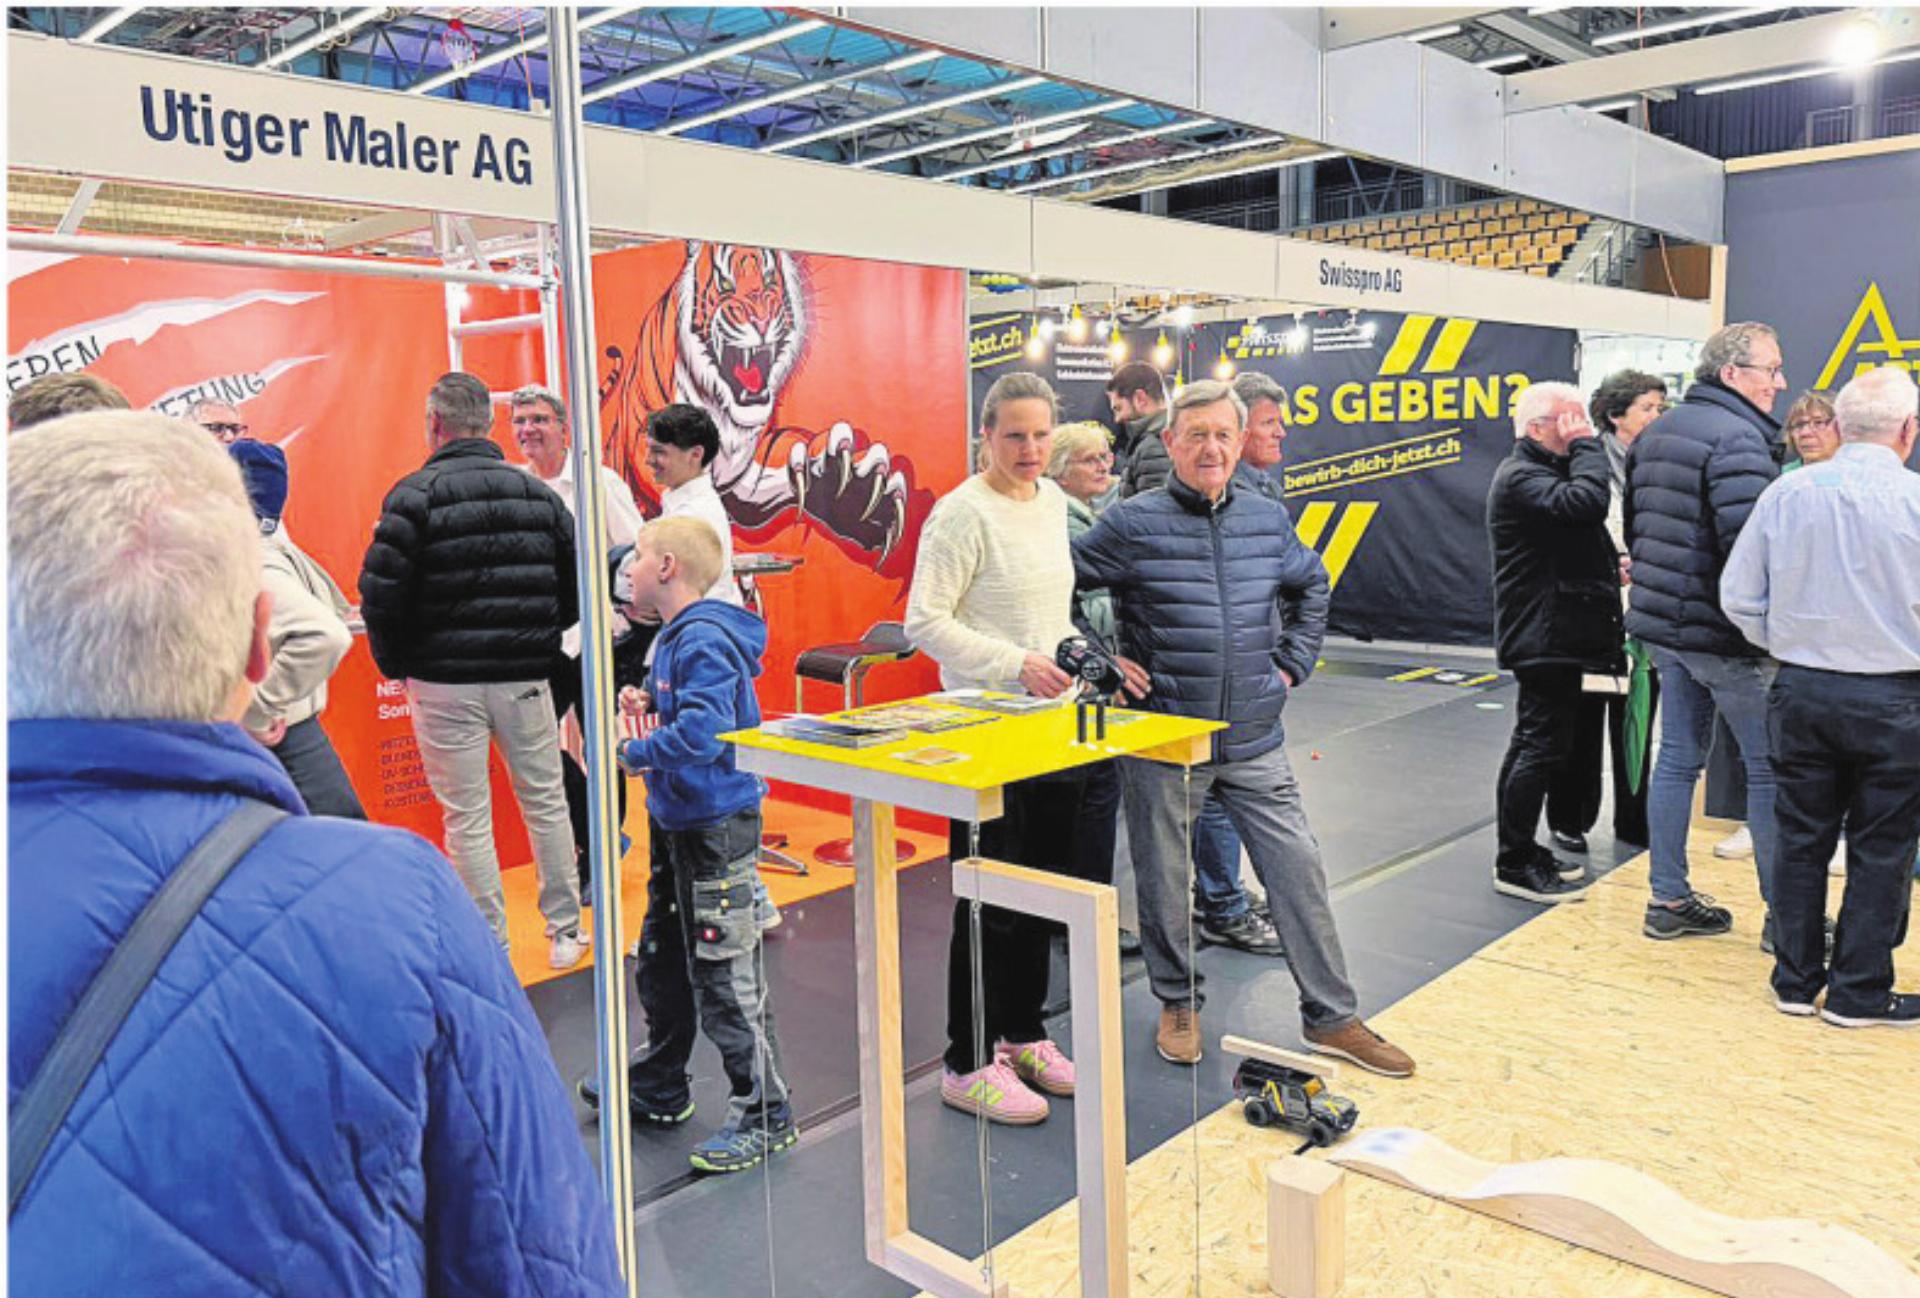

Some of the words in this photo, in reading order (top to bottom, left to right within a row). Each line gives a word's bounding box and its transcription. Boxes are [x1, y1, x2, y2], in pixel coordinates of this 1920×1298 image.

[140, 85, 309, 164] Utiger
[323, 111, 460, 176] Maler
[472, 132, 533, 185] AG
[1320, 257, 1382, 295] Swisspro
[1384, 267, 1402, 292] AG
[1331, 373, 1529, 424] GEBEN?
[1284, 438, 1461, 490] bewirb-dich-jetzt.ch
